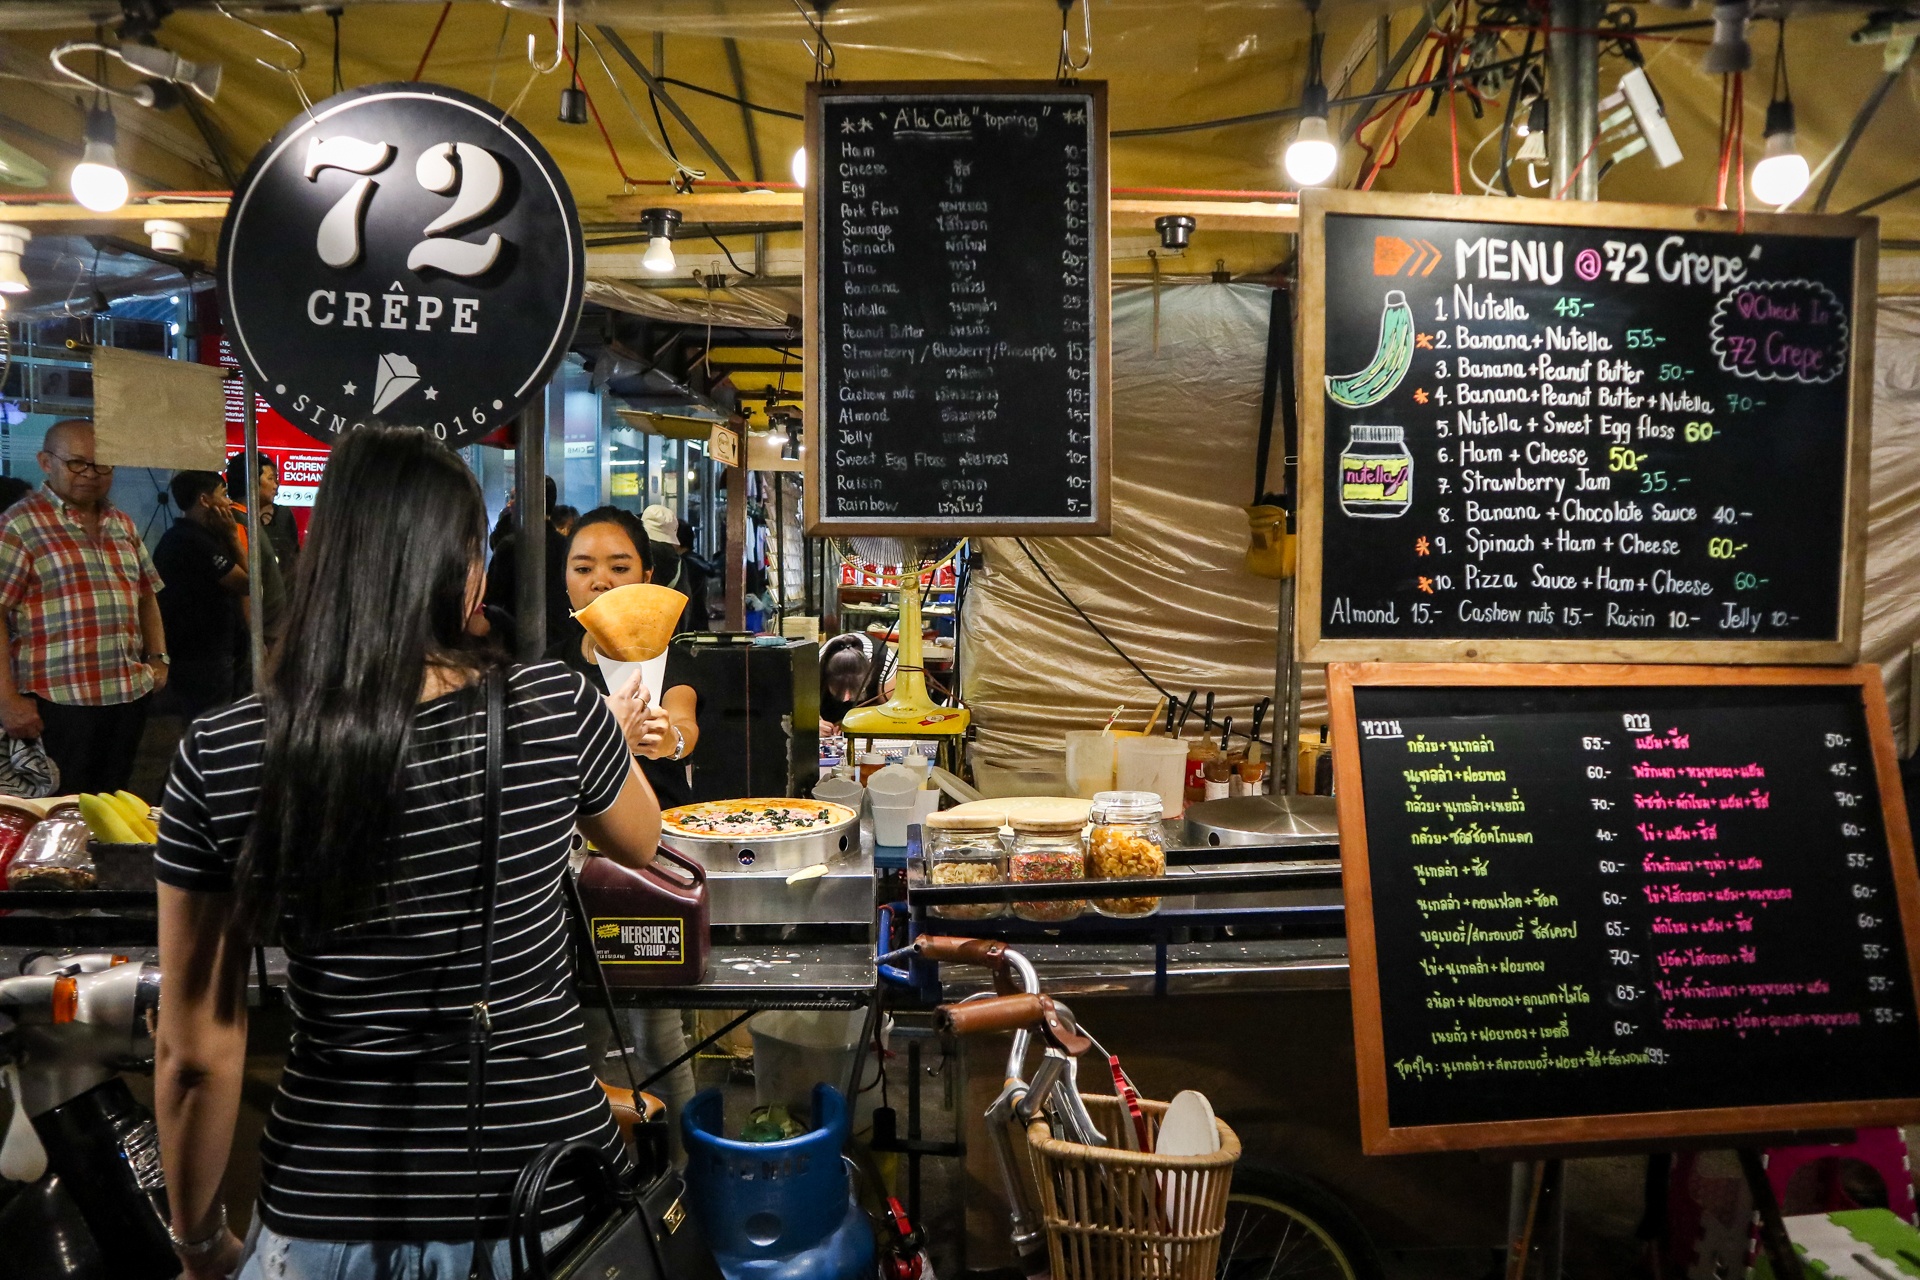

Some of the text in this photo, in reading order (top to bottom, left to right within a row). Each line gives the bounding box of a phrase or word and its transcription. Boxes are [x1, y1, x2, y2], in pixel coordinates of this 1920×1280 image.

[842, 142, 875, 158] Ham
[839, 163, 887, 176] Cheese
[842, 182, 866, 198] Egg
[303, 136, 503, 277] 72
[841, 202, 867, 218] Pork
[842, 220, 892, 241] Sausage
[842, 239, 895, 256] Spinach
[842, 263, 877, 274] Tuna
[1455, 237, 1564, 285] MENU
[845, 281, 900, 295] Banana
[307, 281, 480, 335] CRÊPE
[843, 302, 888, 317] Nutella
[1454, 284, 1530, 322] Nutella
[1728, 336, 1758, 364] 72
[1597, 359, 1645, 385] Butter
[416, 406, 487, 443] 016
[839, 409, 890, 424] Almond
[1458, 410, 1522, 435] Nutella
[1543, 411, 1593, 435] Sweet
[1600, 415, 1631, 444] Egg
[1637, 414, 1675, 440] floss
[839, 430, 873, 448] Jelly
[836, 450, 876, 466] Sweet
[1460, 440, 1503, 467] Ham
[1526, 440, 1589, 465] Cheese
[284, 461, 326, 472] CURREN
[1347, 464, 1396, 485] nutella
[284, 472, 325, 482] EXCHAN
[837, 475, 883, 490] Raisin
[1462, 468, 1566, 503] Strawberry
[1574, 468, 1611, 491] Jam
[837, 498, 899, 512] Rainbow
[1466, 500, 1541, 522] Banana
[1652, 503, 1698, 522] Sauce
[1466, 527, 1535, 561] Spinach
[1556, 528, 1597, 551] Ham
[1619, 533, 1681, 556] Cheese
[1466, 564, 1518, 590] Pizza
[1532, 563, 1578, 589] Sauce
[1329, 597, 1400, 626] Almond
[1458, 599, 1522, 624] Cashew
[1527, 602, 1556, 625] nuts
[1605, 602, 1656, 628] Raisin
[1718, 602, 1763, 634] Jelly
[1361, 720, 1403, 736] หวาน
[620, 925, 680, 945] HERSHEY'S
[634, 944, 666, 957] SYRUP
